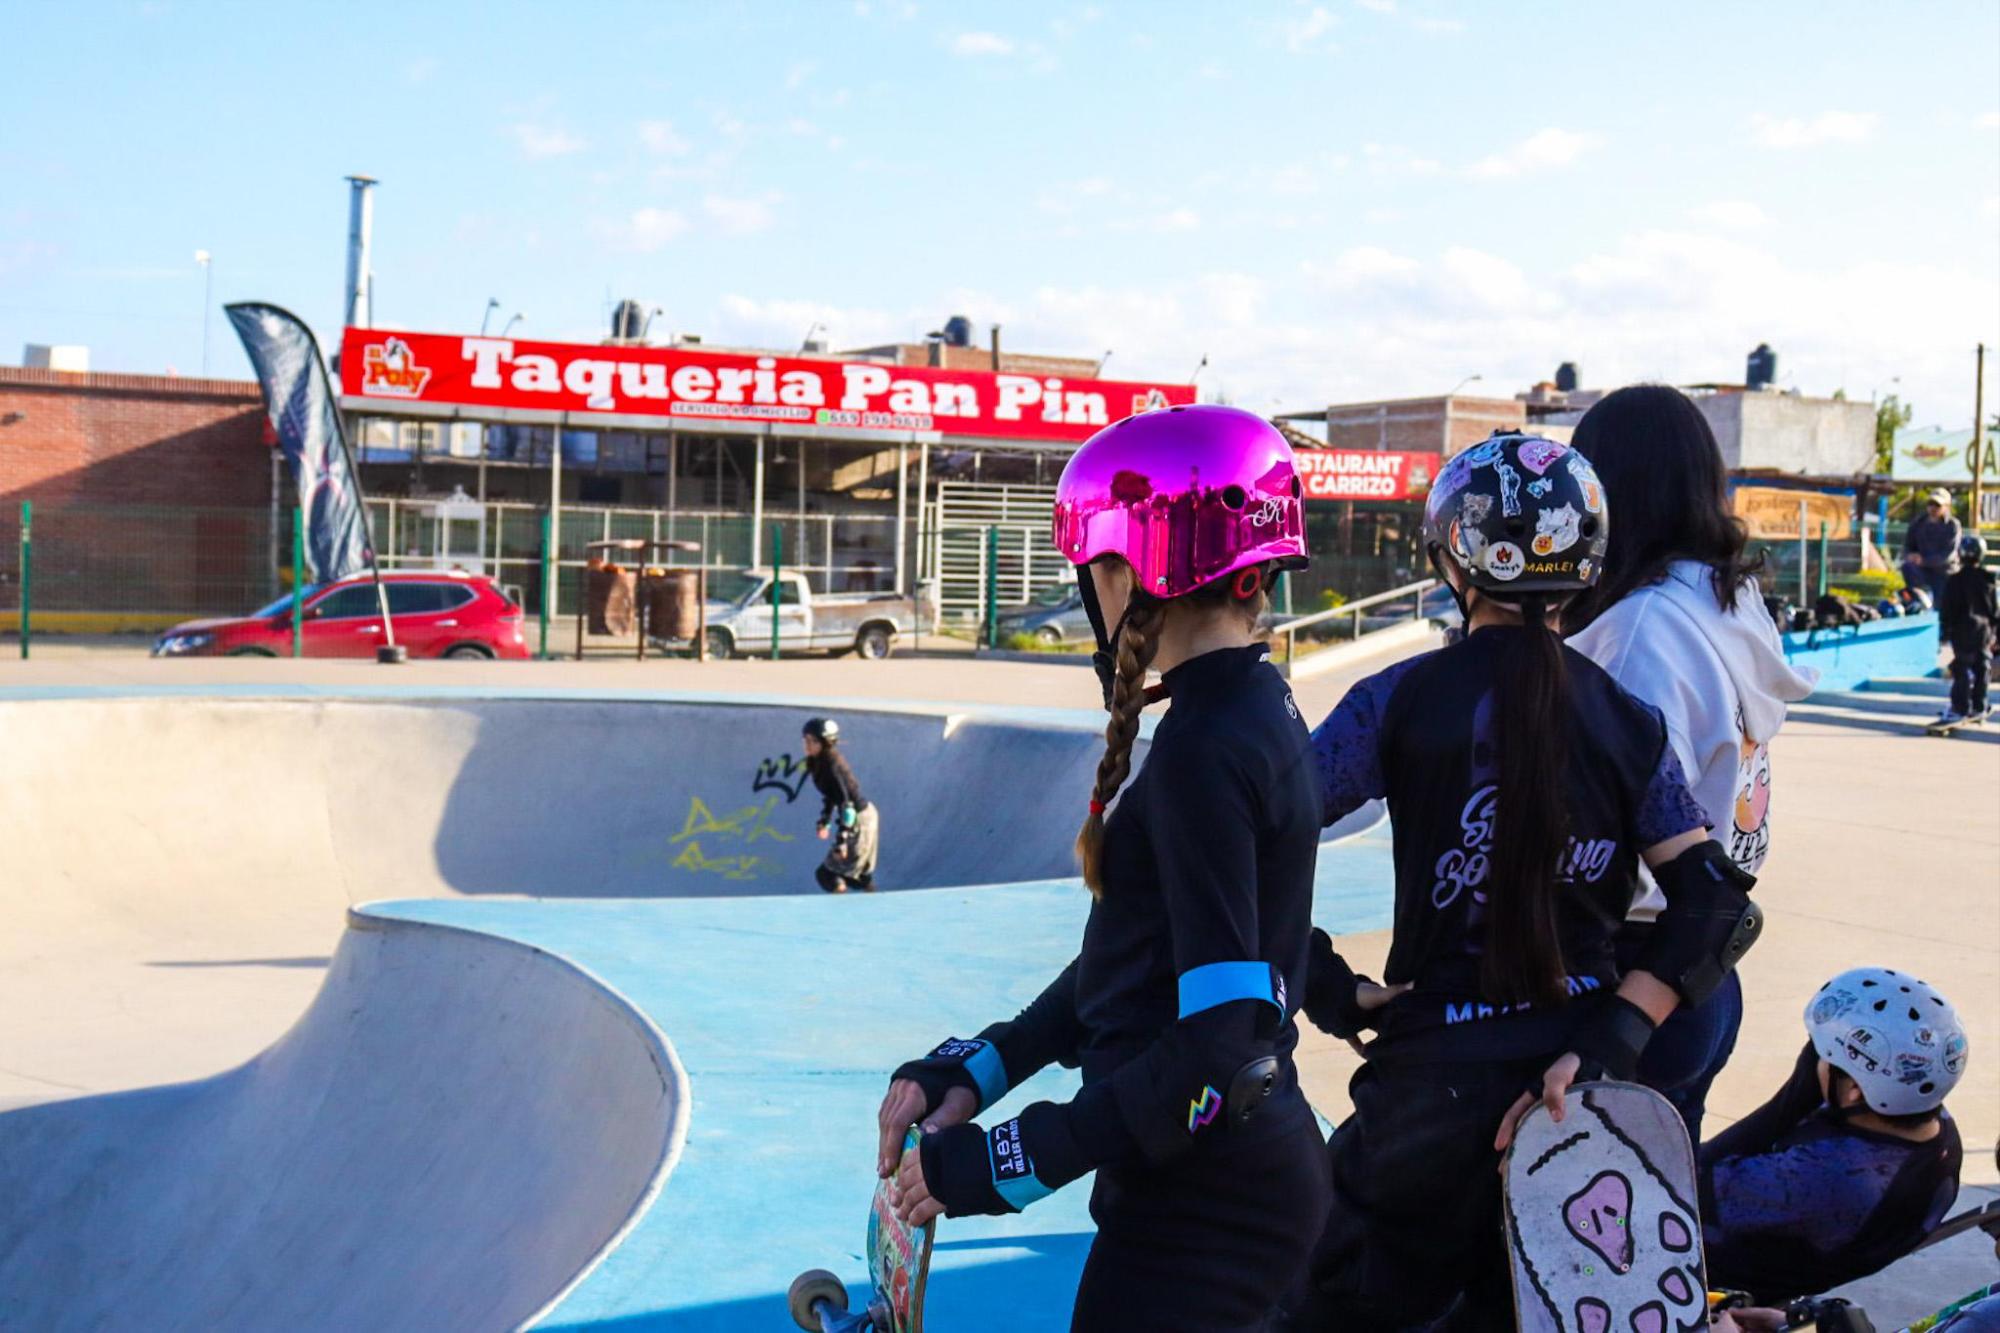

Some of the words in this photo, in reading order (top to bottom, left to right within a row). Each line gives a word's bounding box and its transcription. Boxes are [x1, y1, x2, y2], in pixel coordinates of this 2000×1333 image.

[461, 338, 825, 410] Taqueria
[840, 364, 980, 418] Pan
[994, 374, 1109, 426] Pin
[1309, 474, 1396, 496] CARRIZO
[995, 1125, 1014, 1172] 187
[1011, 1141, 1026, 1174] KILLER
